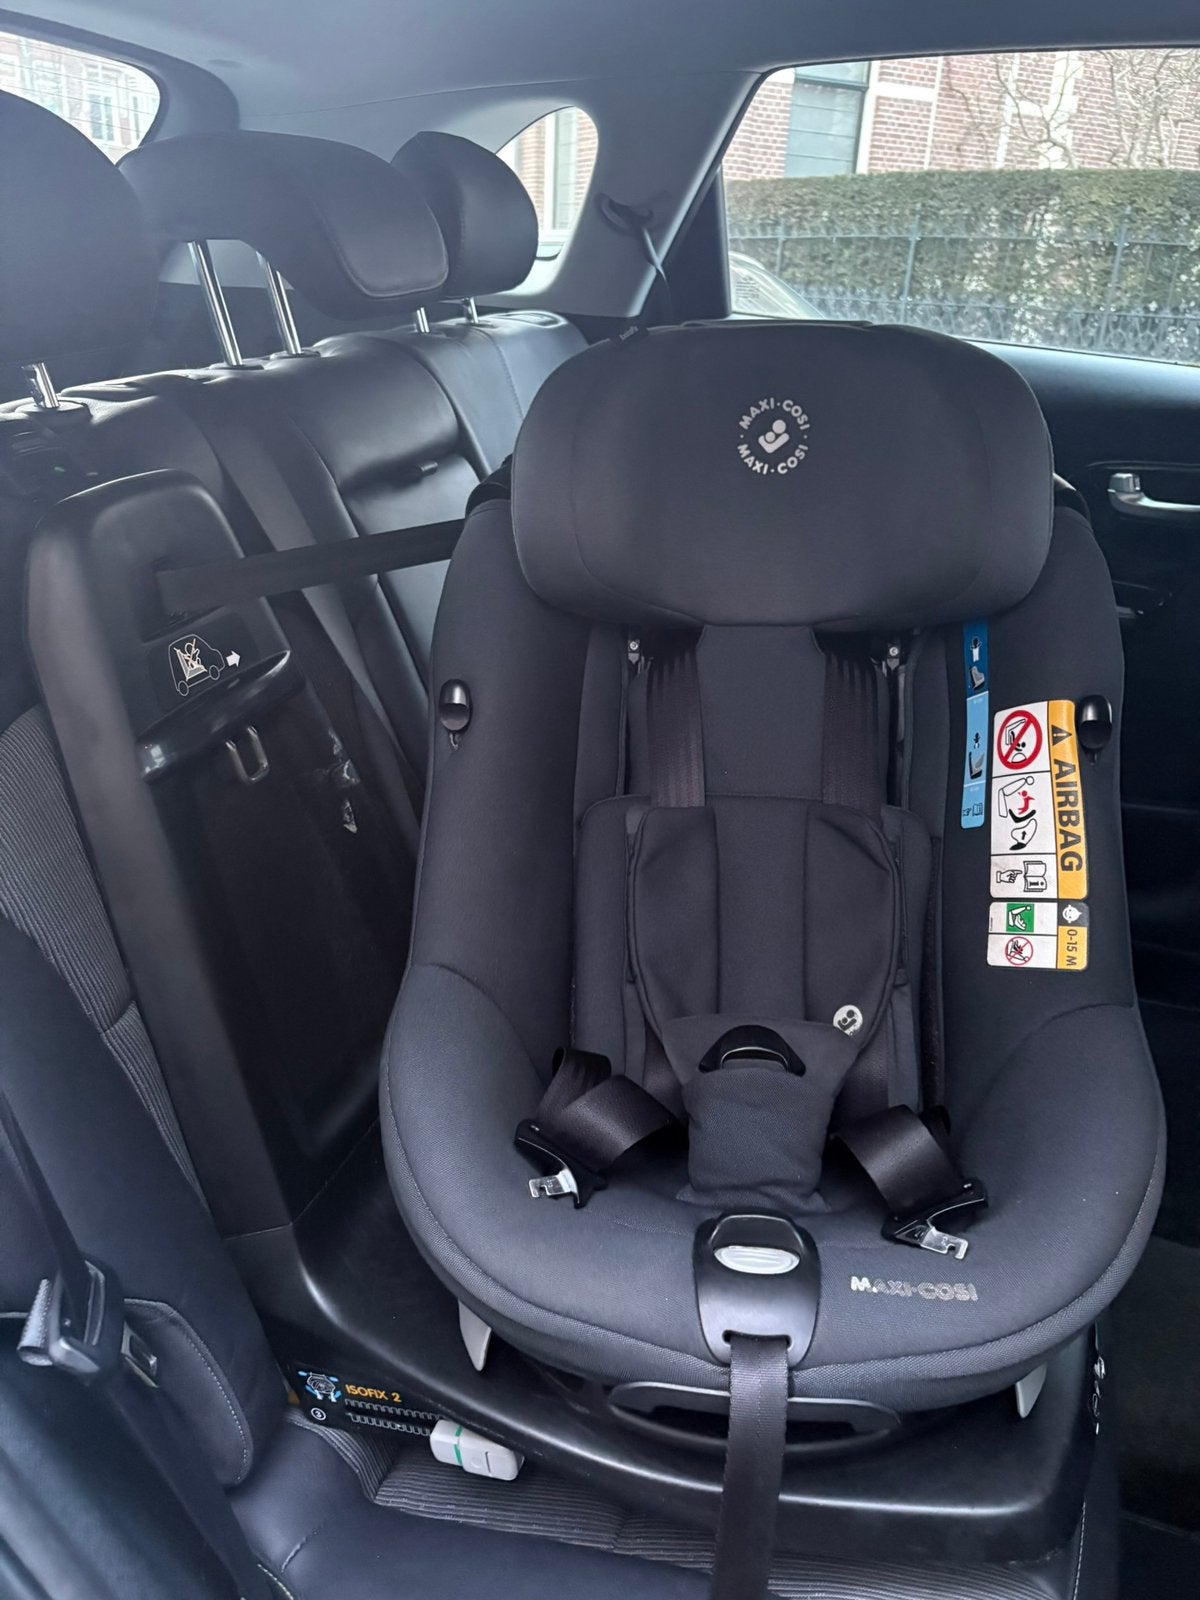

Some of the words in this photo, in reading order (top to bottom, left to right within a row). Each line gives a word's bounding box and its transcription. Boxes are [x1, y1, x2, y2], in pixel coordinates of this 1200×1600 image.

[1053, 758, 1083, 872] AIRBAG
[1066, 929, 1078, 952] 0-15
[1065, 955, 1077, 966] M
[345, 1384, 389, 1400] ISOFIX
[391, 1392, 402, 1403] 2
